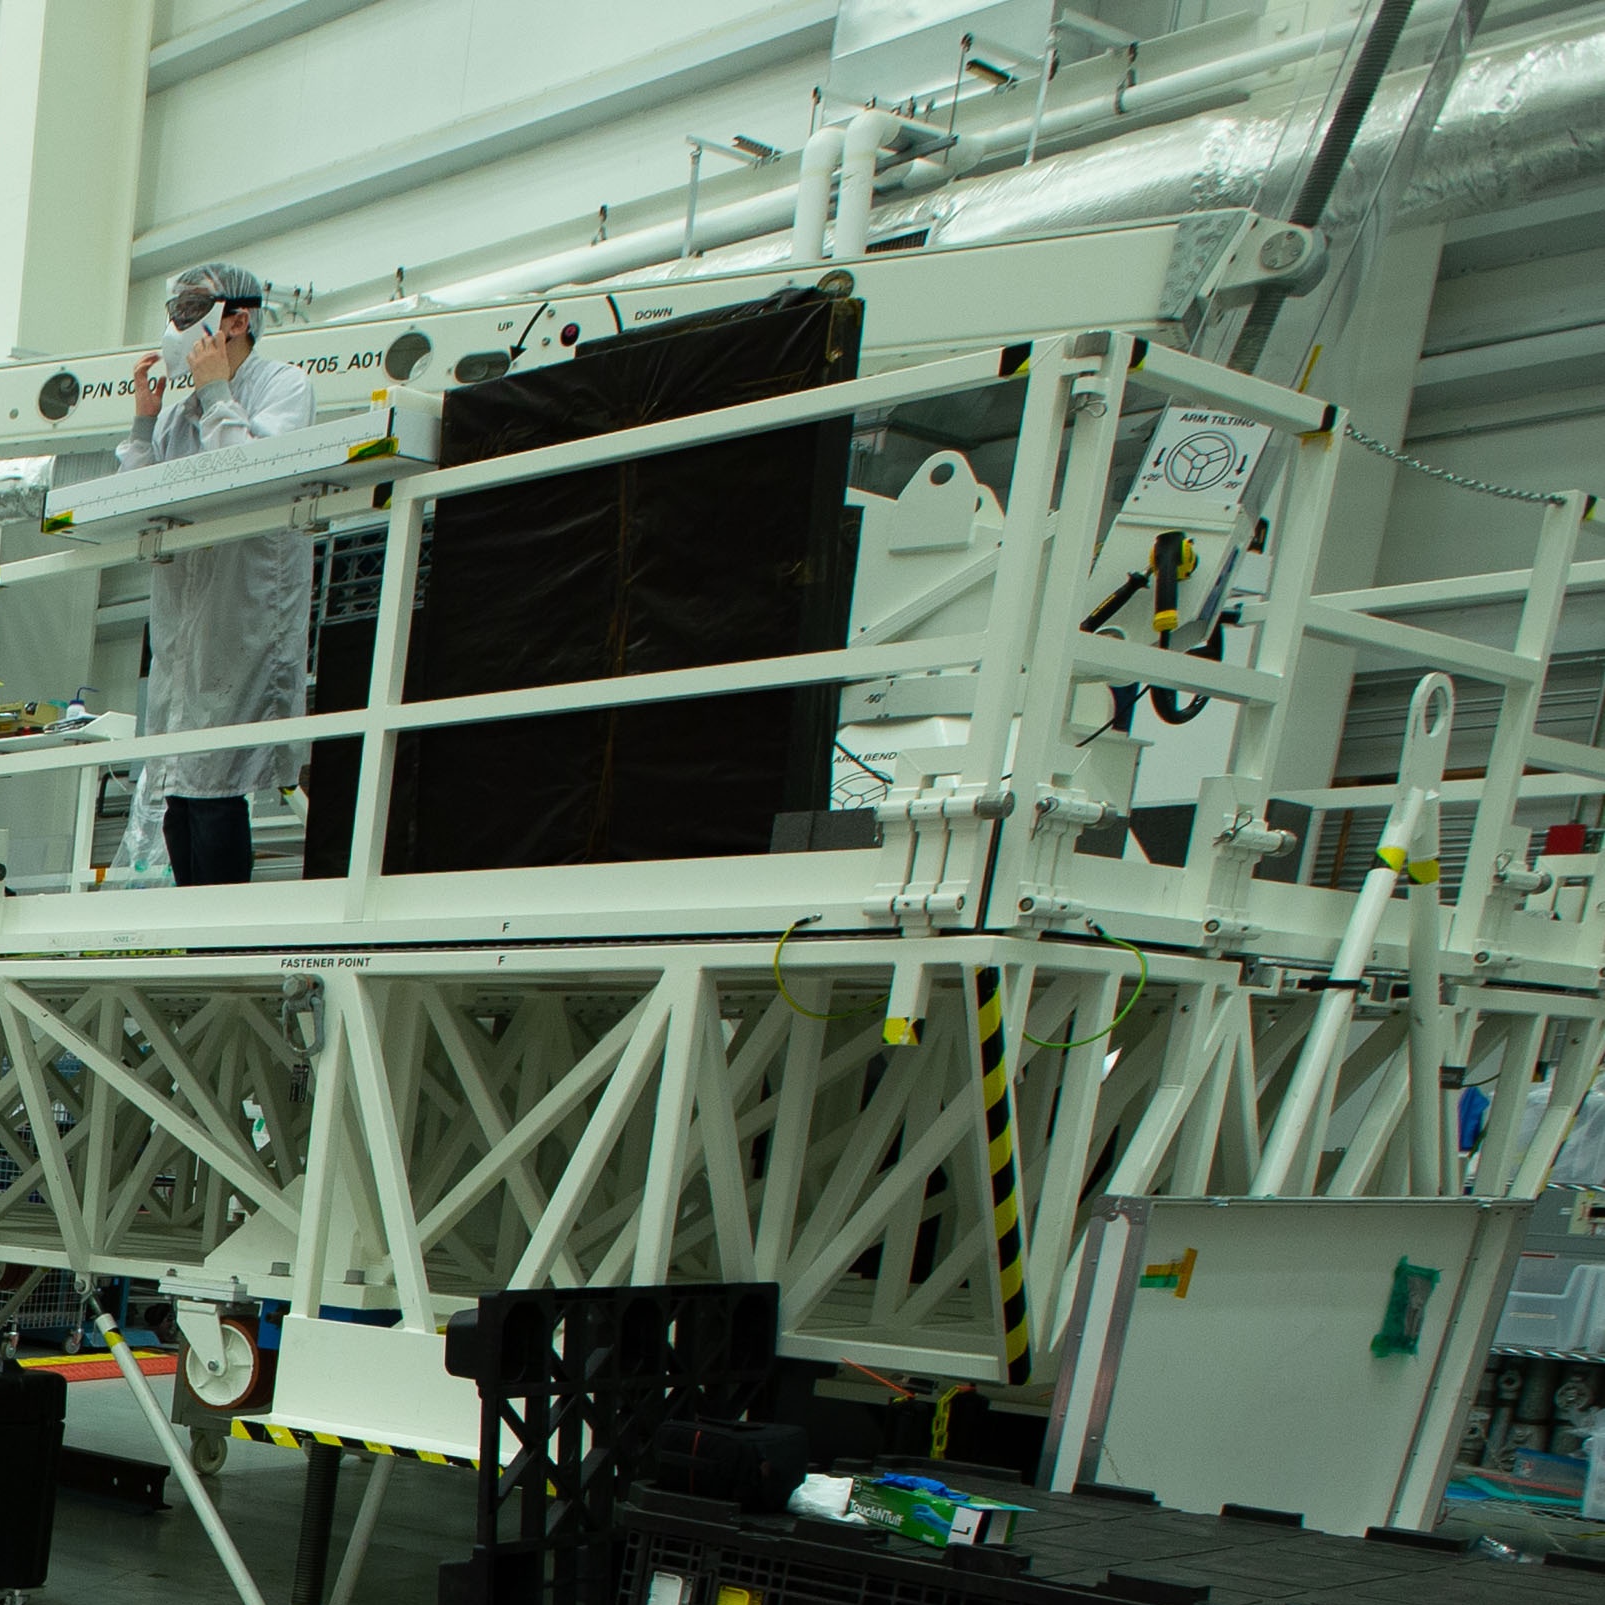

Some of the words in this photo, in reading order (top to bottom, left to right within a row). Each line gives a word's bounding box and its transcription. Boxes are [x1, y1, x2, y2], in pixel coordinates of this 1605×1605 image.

[634, 307, 673, 321] DOWN
[497, 321, 514, 332] UP
[82, 380, 114, 401] P/N
[1179, 413, 1209, 424] ARM
[1210, 415, 1256, 428] TILTING
[162, 446, 248, 480] MAGMA
[502, 922, 511, 933] F
[280, 958, 334, 969] FASTENER
[338, 956, 371, 968] POINT
[497, 955, 506, 966] F
[848, 1499, 905, 1528] TouchNTuff
